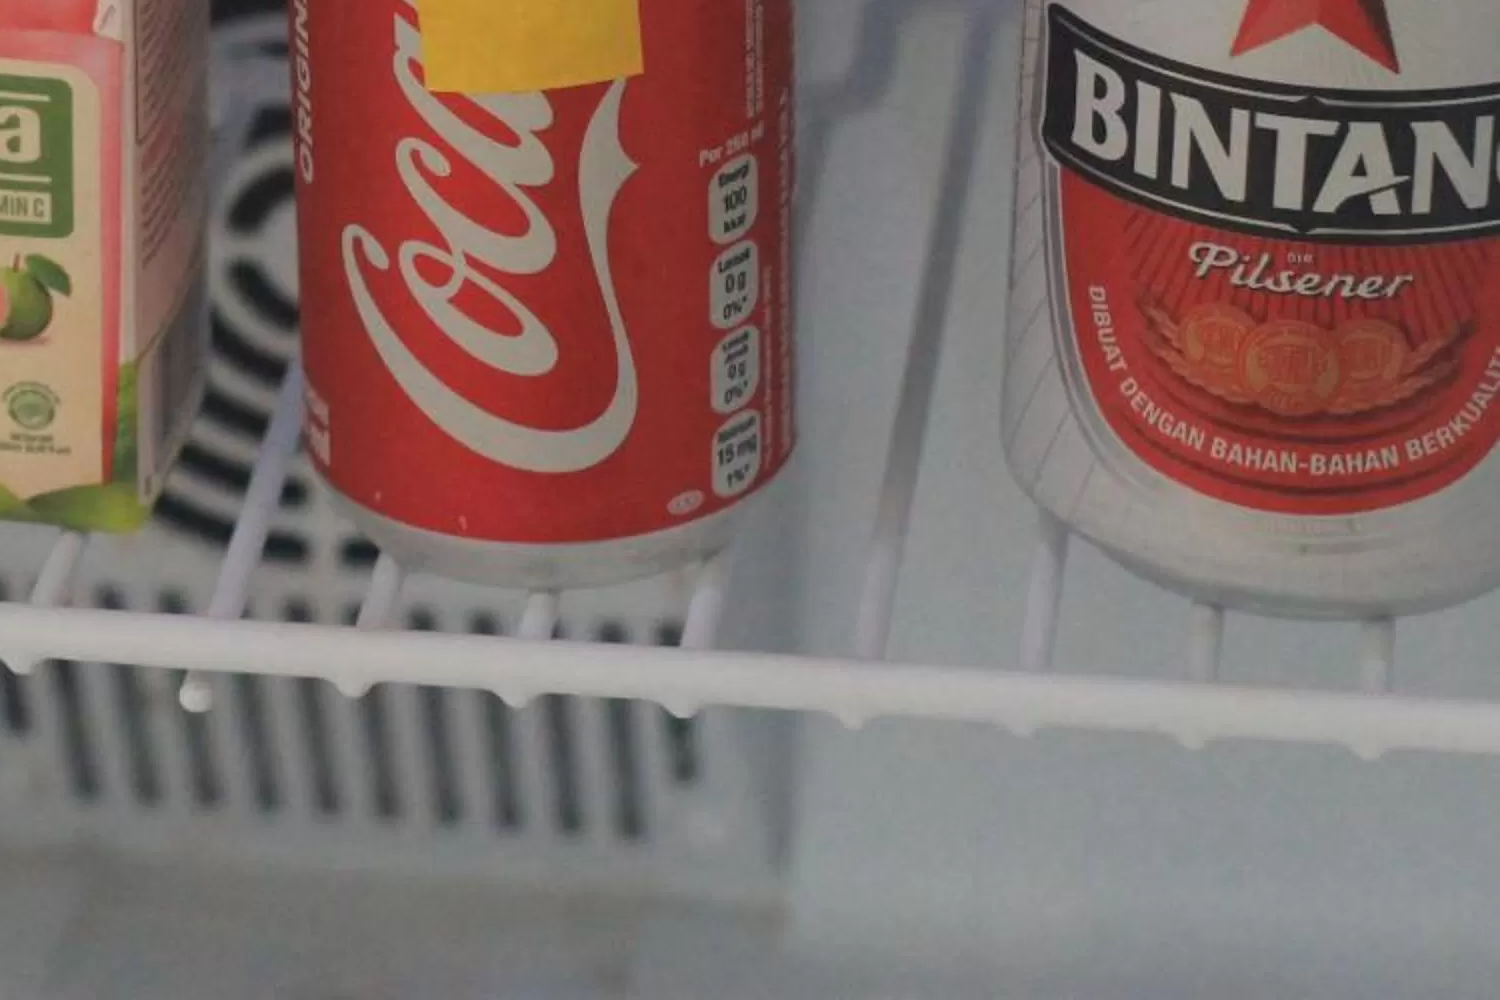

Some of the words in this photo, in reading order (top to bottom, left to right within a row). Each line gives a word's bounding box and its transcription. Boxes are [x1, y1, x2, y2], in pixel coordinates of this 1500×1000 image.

[1071, 48, 1500, 216] BINTAN
[32, 197, 45, 218] C
[723, 185, 747, 213] 100
[1188, 241, 1414, 299] Pilsener
[1087, 284, 1128, 375] DIBUAT
[1118, 377, 1206, 452] DENGAN
[1209, 436, 1400, 478] BAHAN-BAHAN
